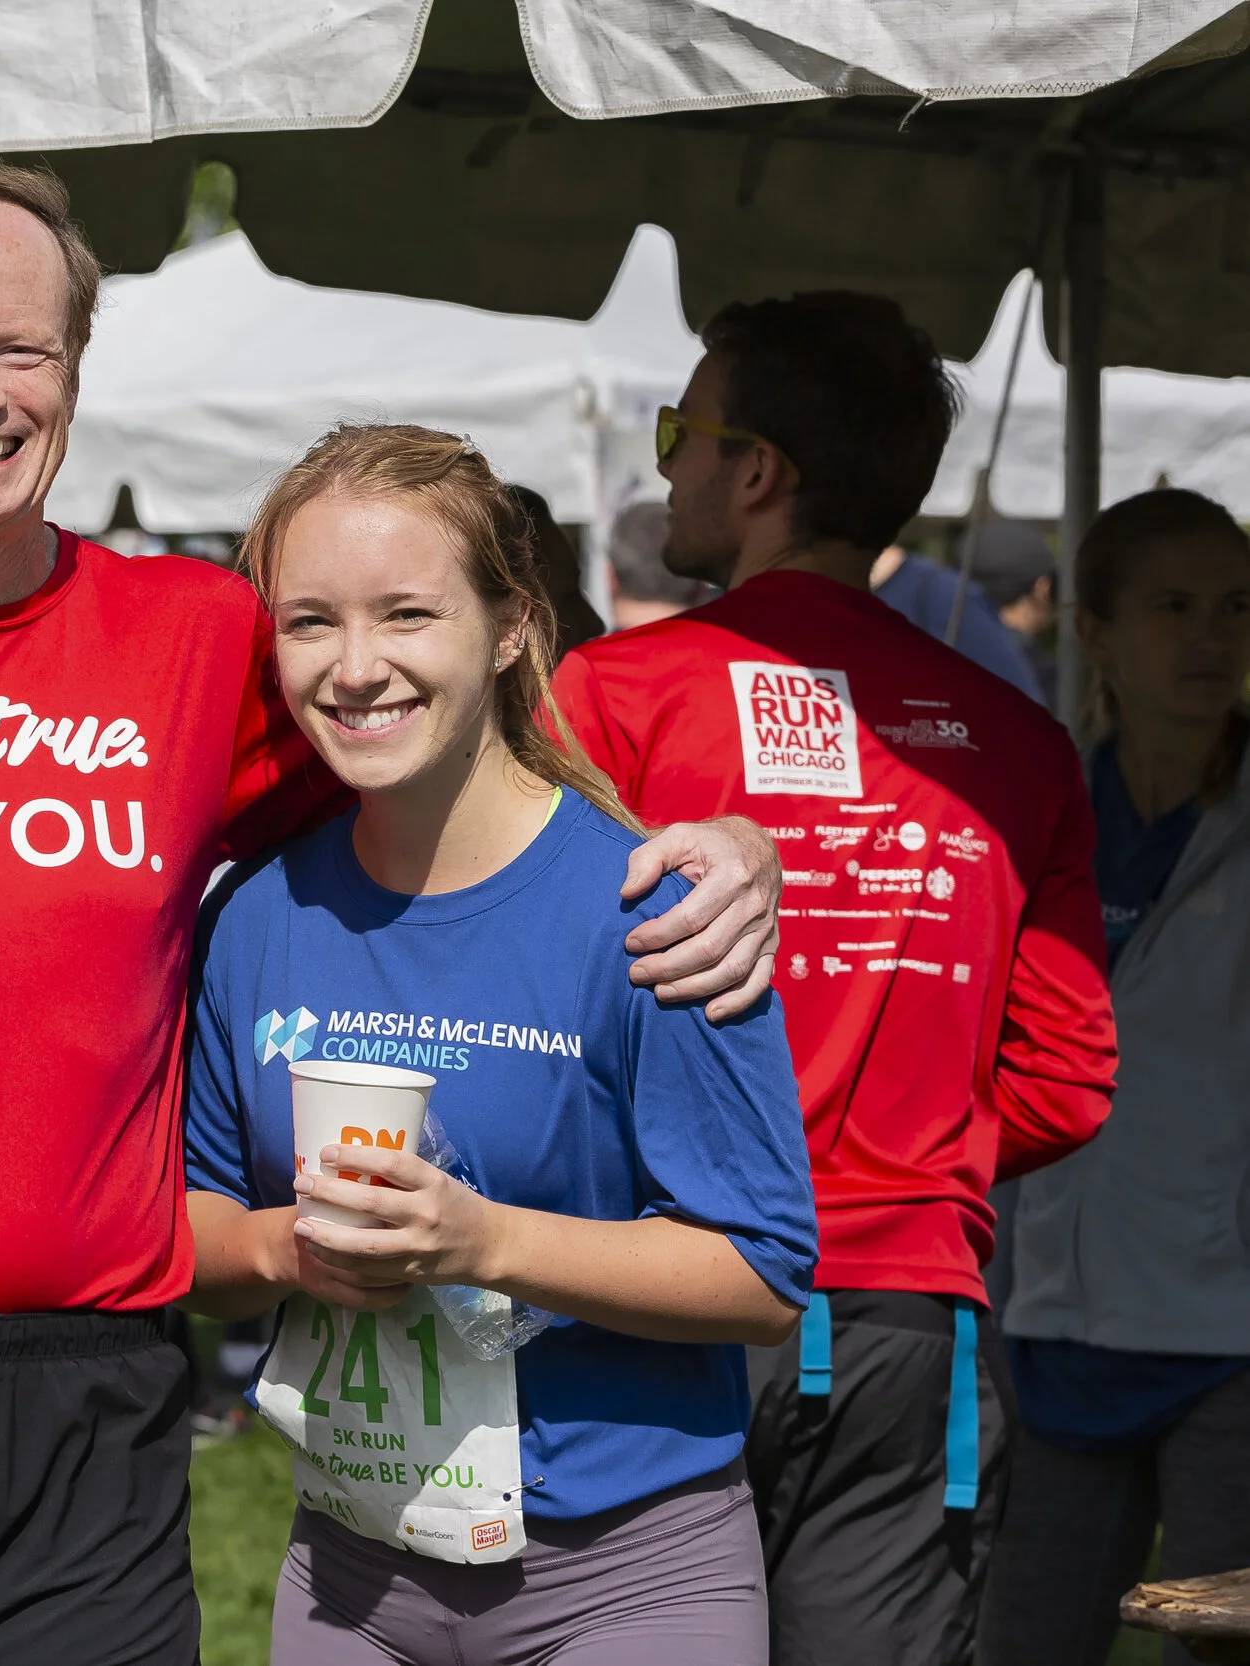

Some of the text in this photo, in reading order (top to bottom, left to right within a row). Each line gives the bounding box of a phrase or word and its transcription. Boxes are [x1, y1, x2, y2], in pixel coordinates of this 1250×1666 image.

[751, 672, 838, 701] AIDS
[751, 697, 842, 729] RUN
[755, 727, 845, 754] WALK
[935, 719, 969, 739] 30
[758, 751, 846, 771] CHICAGO
[327, 1010, 415, 1038] MARSH
[417, 1015, 436, 1039] &
[322, 1036, 470, 1071] COMPANIES
[298, 1302, 442, 1426] 241
[333, 1428, 405, 1452] 5K RUN
[378, 1461, 407, 1485] BE
[414, 1463, 483, 1489] YOU.
[416, 1525, 501, 1541] MillerCoors Oscar
[476, 1532, 503, 1545] Mayer
